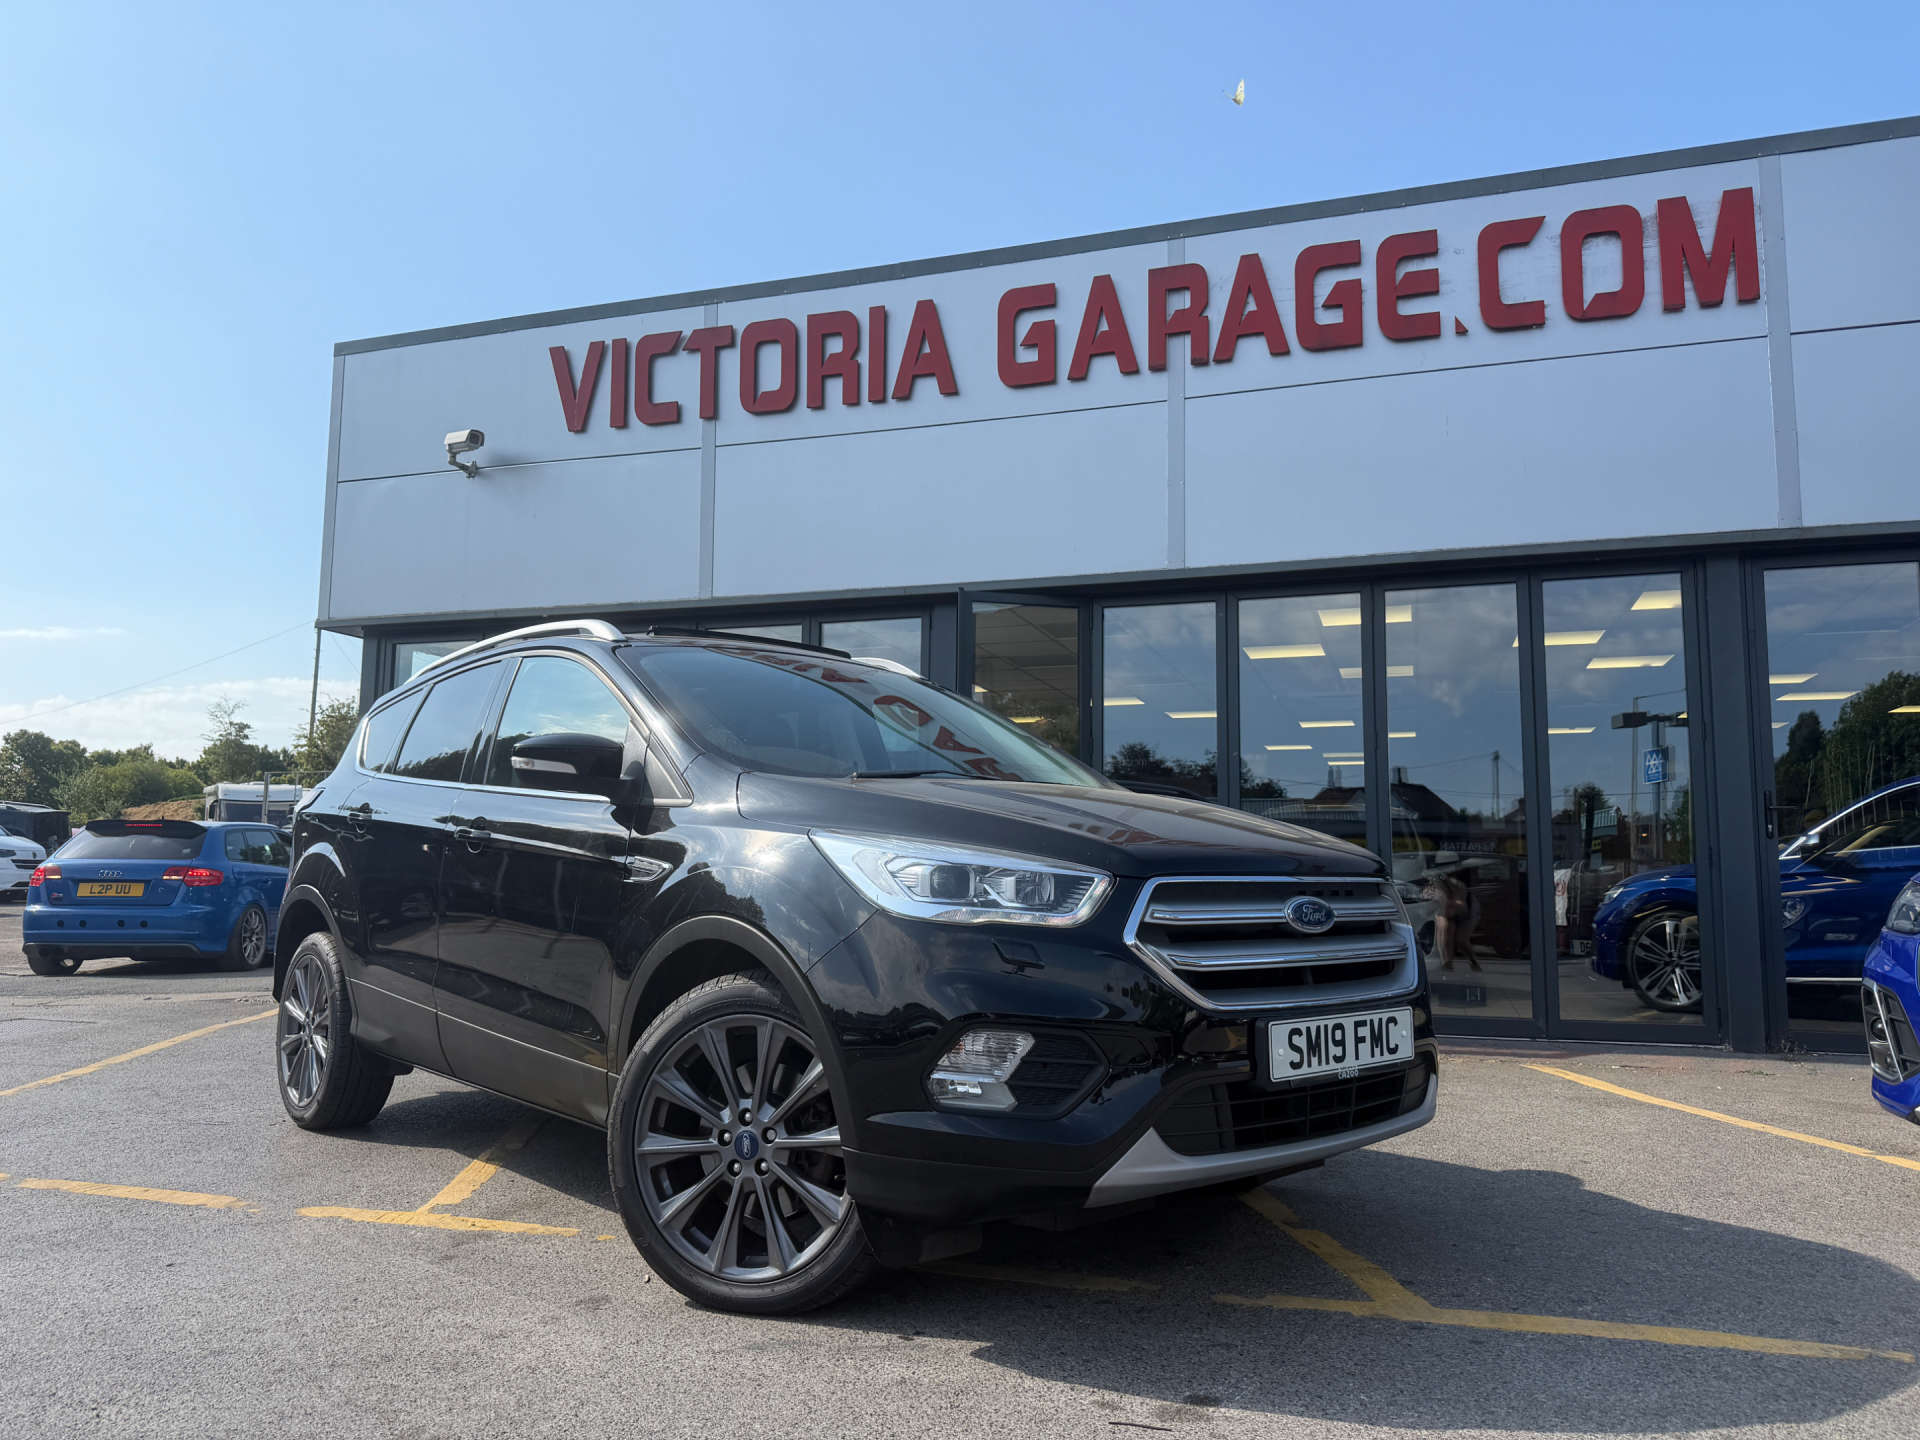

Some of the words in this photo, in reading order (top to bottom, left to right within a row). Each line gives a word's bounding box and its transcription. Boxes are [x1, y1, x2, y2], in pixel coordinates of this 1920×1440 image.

[548, 299, 959, 433] VICTORIA
[997, 187, 1760, 388] GARAGE.COM
[89, 884, 112, 895] L2P
[1302, 903, 1327, 922] Ford
[1287, 1022, 1347, 1071] SM19
[1353, 1015, 1399, 1061] FMC
